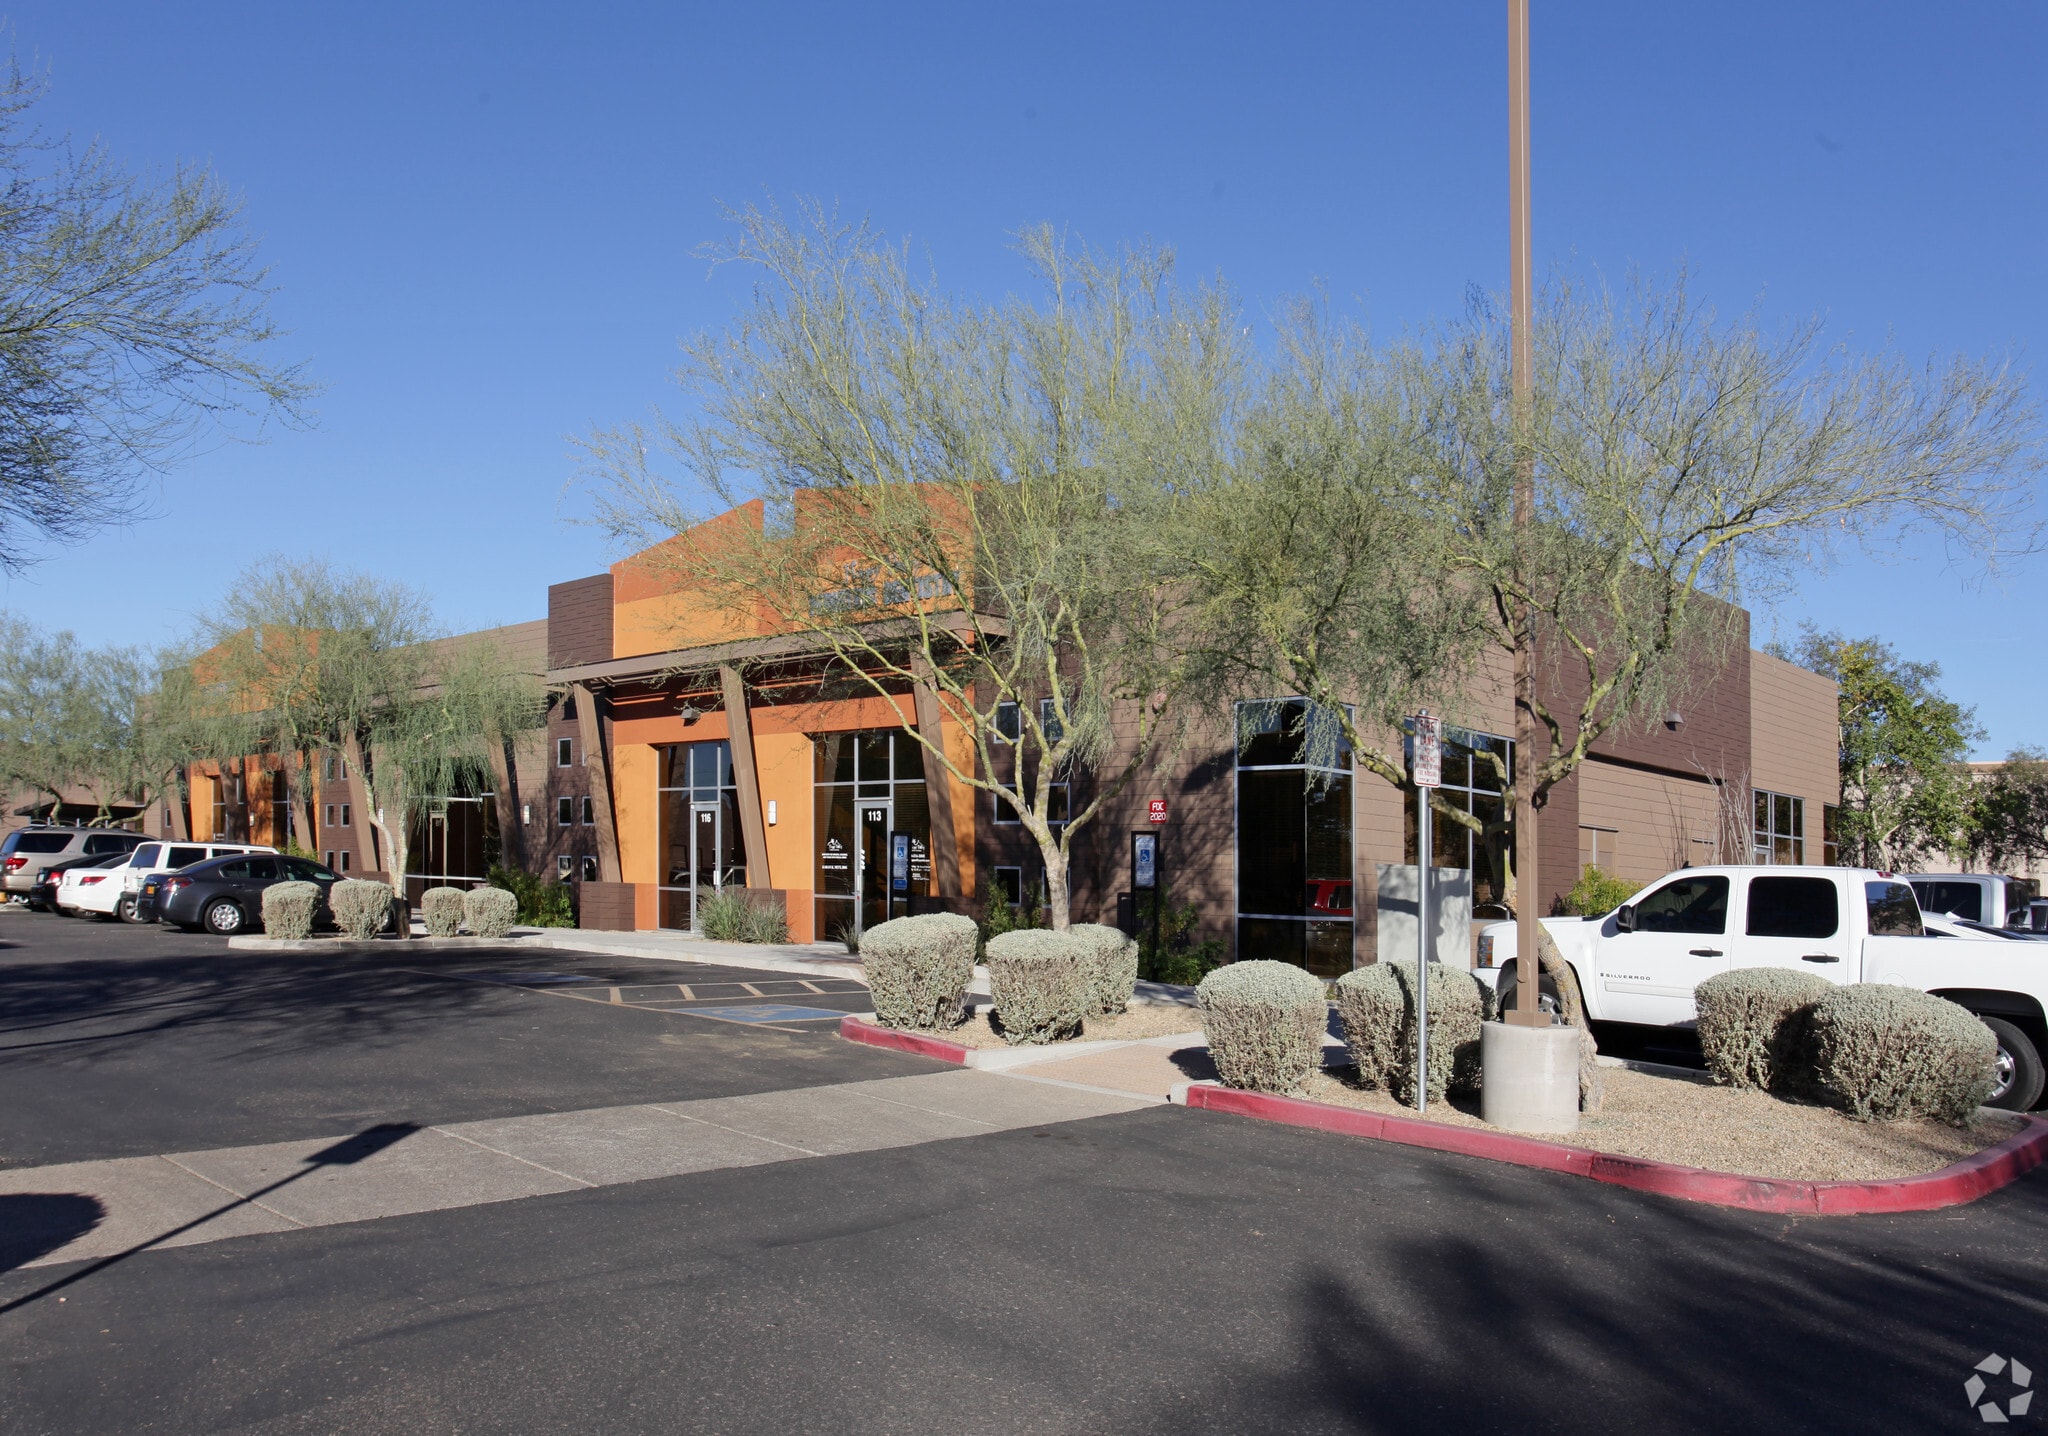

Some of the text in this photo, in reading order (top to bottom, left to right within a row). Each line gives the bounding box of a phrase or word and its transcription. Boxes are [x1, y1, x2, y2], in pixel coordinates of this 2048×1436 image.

[701, 813, 711, 823] 116
[868, 811, 881, 821] 113
[1150, 812, 1166, 821] 2020
[1606, 973, 1651, 981] SILVERADO
